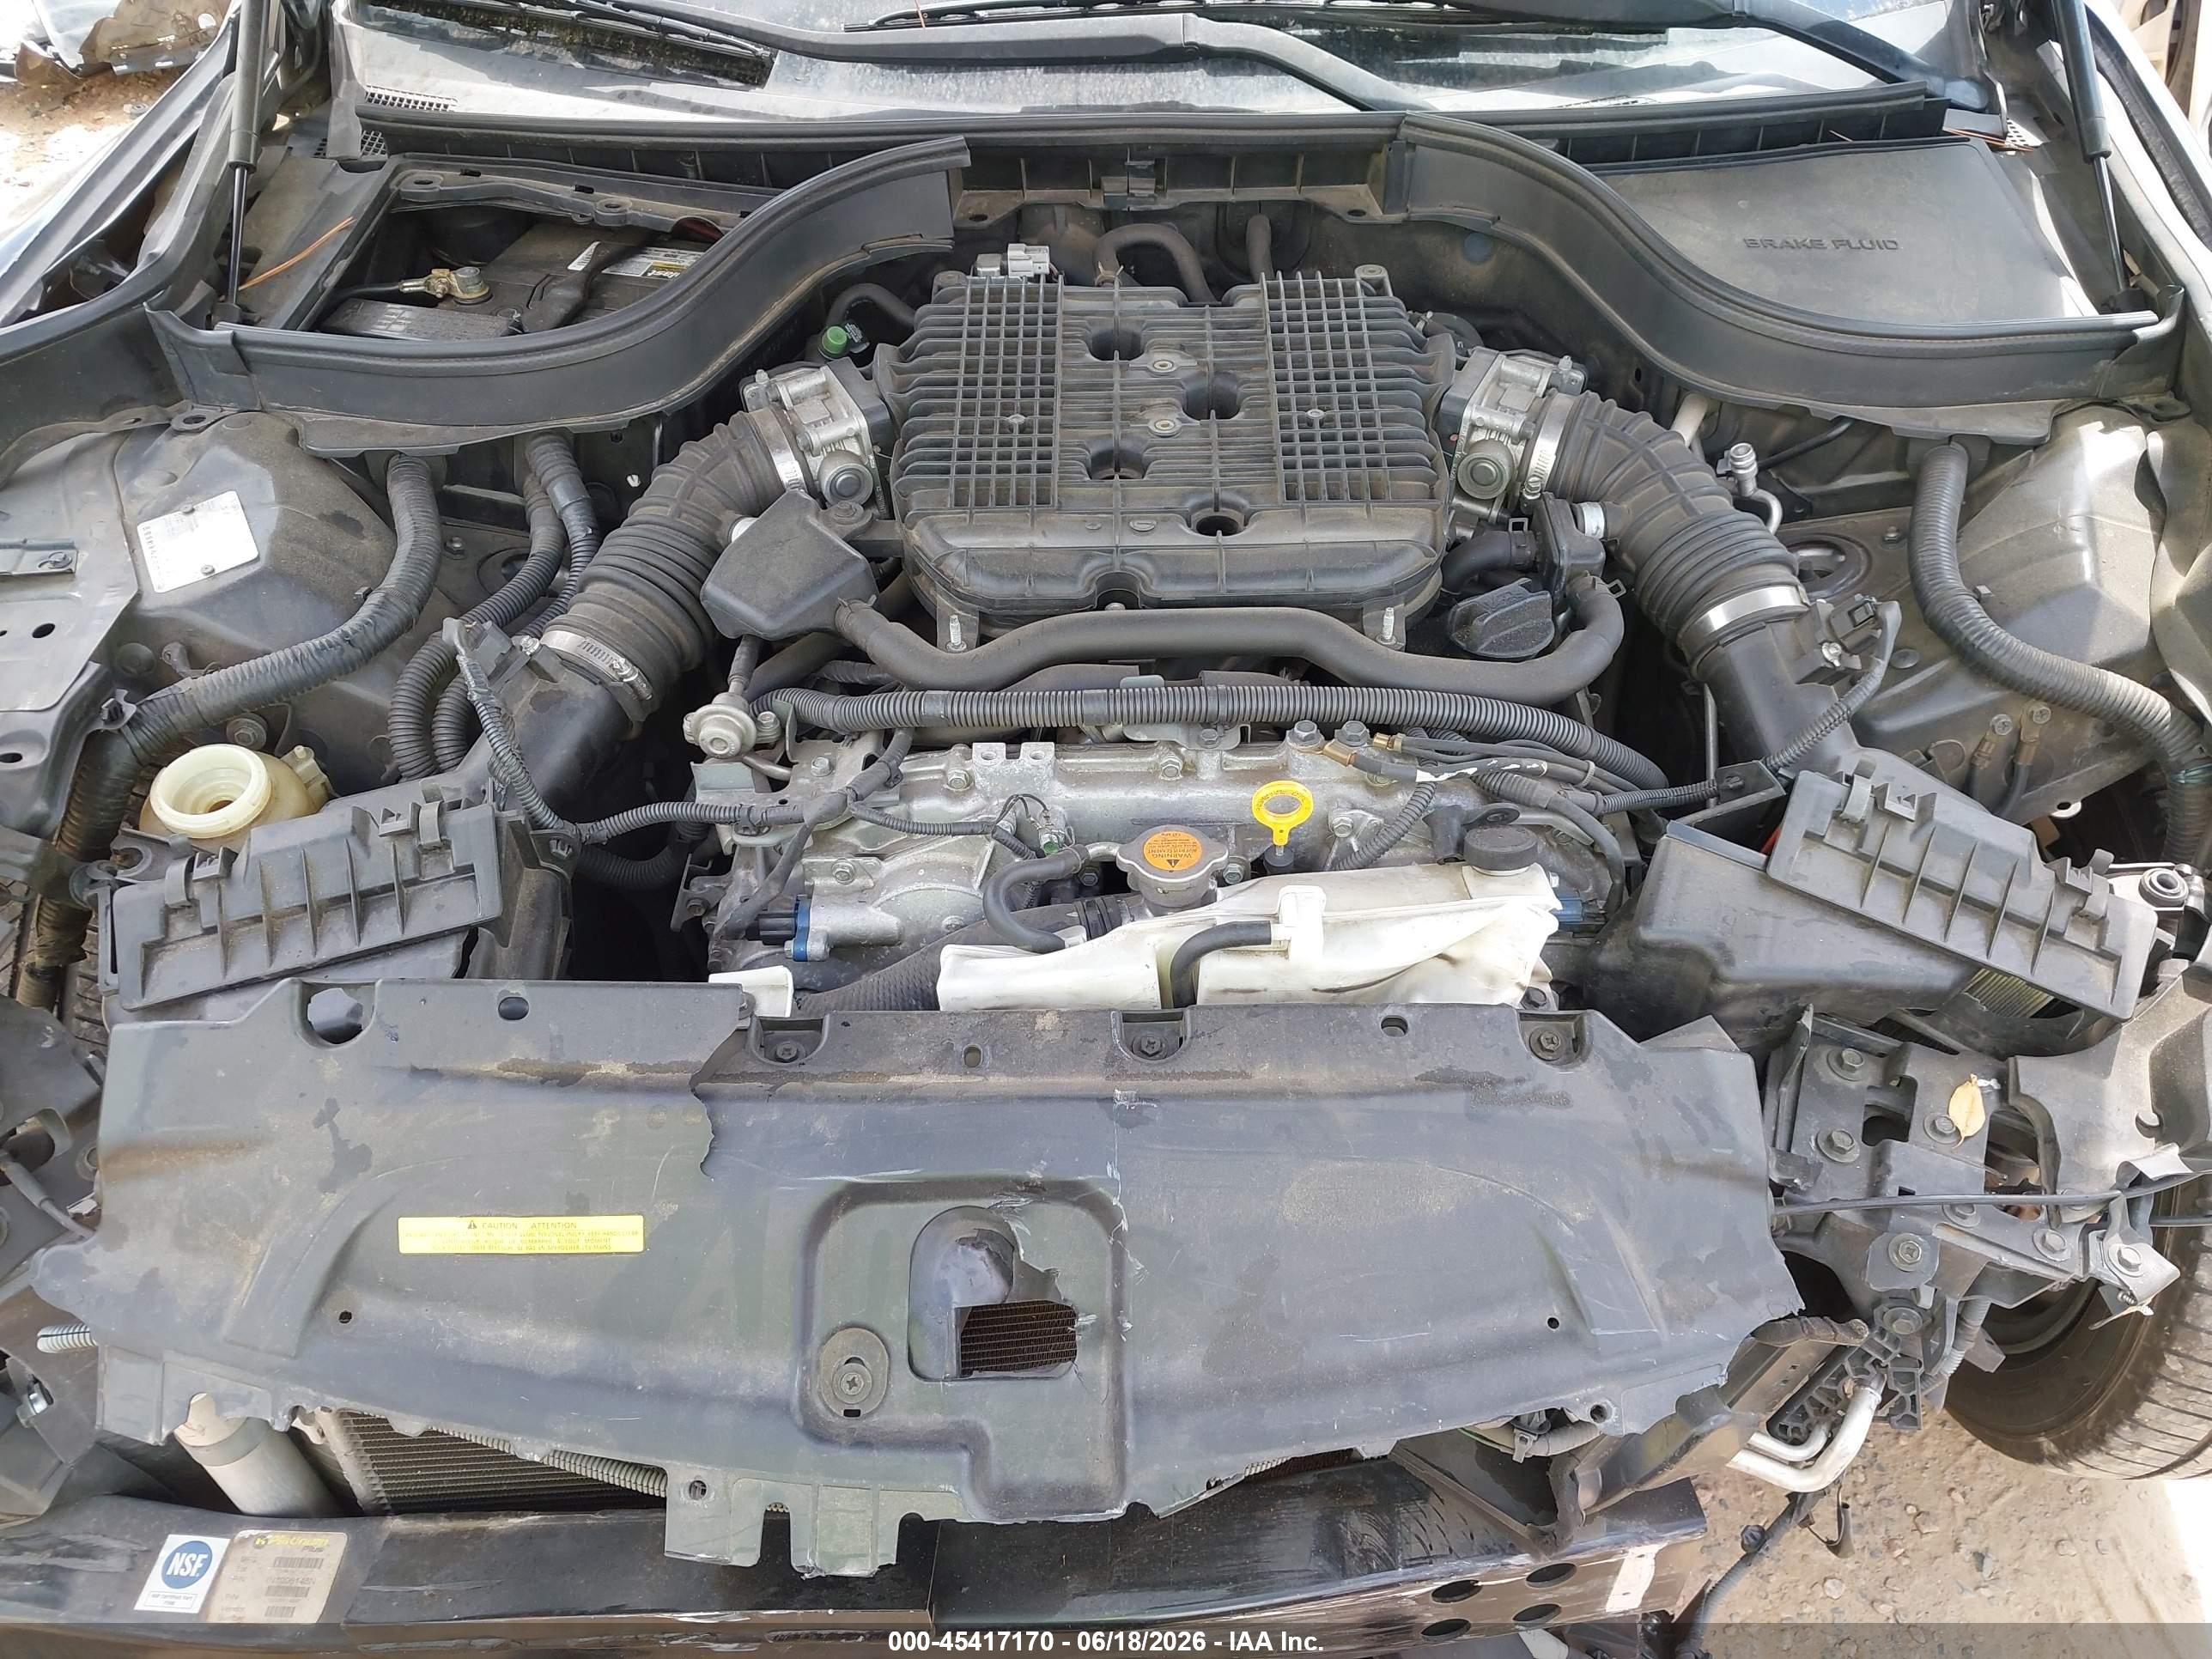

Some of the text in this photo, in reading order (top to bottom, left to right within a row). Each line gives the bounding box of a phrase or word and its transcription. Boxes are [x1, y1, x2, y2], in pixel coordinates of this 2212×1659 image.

[1743, 237, 1899, 251] BRAKE FLUID
[531, 1221, 577, 1230] ATTENTION
[166, 1552, 209, 1577] NSF
